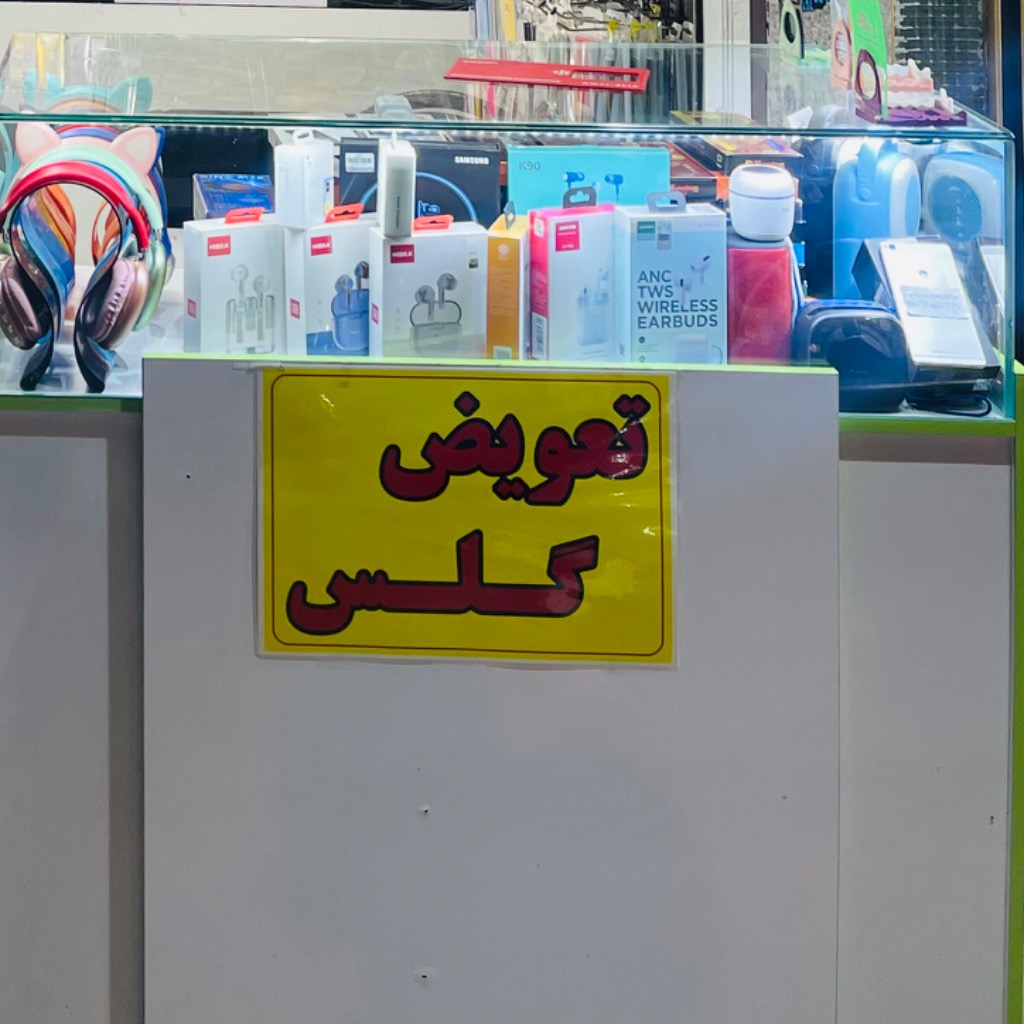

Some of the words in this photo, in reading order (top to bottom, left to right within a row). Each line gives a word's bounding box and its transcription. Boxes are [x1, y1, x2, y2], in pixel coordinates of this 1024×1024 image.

[519, 161, 541, 171] K90
[638, 270, 672, 283] ANC
[637, 285, 674, 298] TWS
[637, 314, 718, 329] EARBUDS
[380, 391, 651, 506] تعویض
[286, 528, 599, 636] گلس
